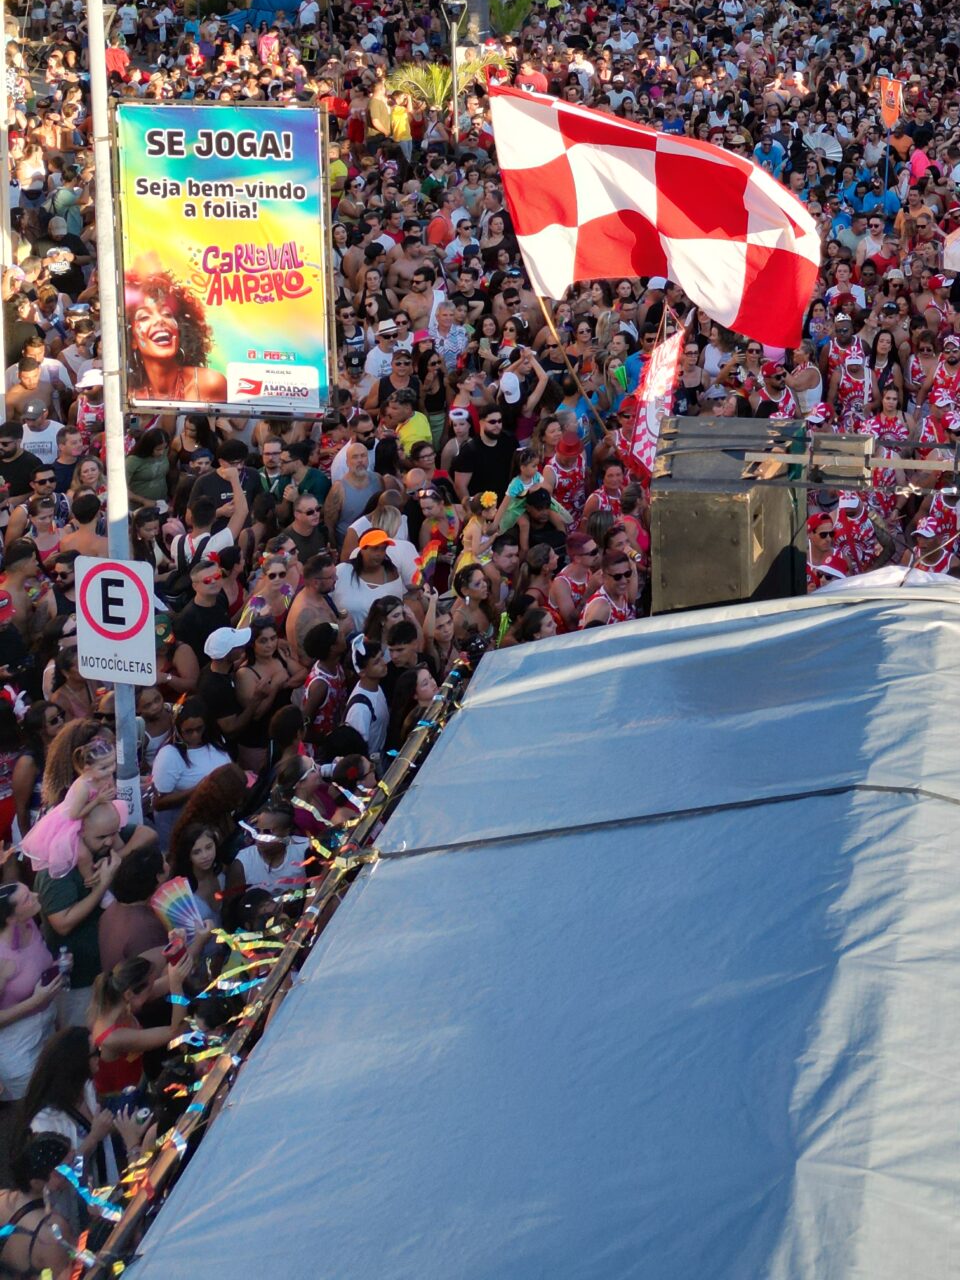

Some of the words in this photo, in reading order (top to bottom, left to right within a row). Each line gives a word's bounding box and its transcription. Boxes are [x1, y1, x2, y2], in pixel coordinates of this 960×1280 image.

[146, 130, 185, 157] SE
[194, 131, 292, 159] JOGA!
[136, 177, 181, 199] Seja
[188, 179, 306, 200] bem-vindo
[184, 203, 197, 217] a
[203, 200, 259, 219] folia!
[263, 384, 309, 398] AMPARO
[100, 577, 126, 626] E
[80, 655, 153, 674] MOTOCICLETAS
